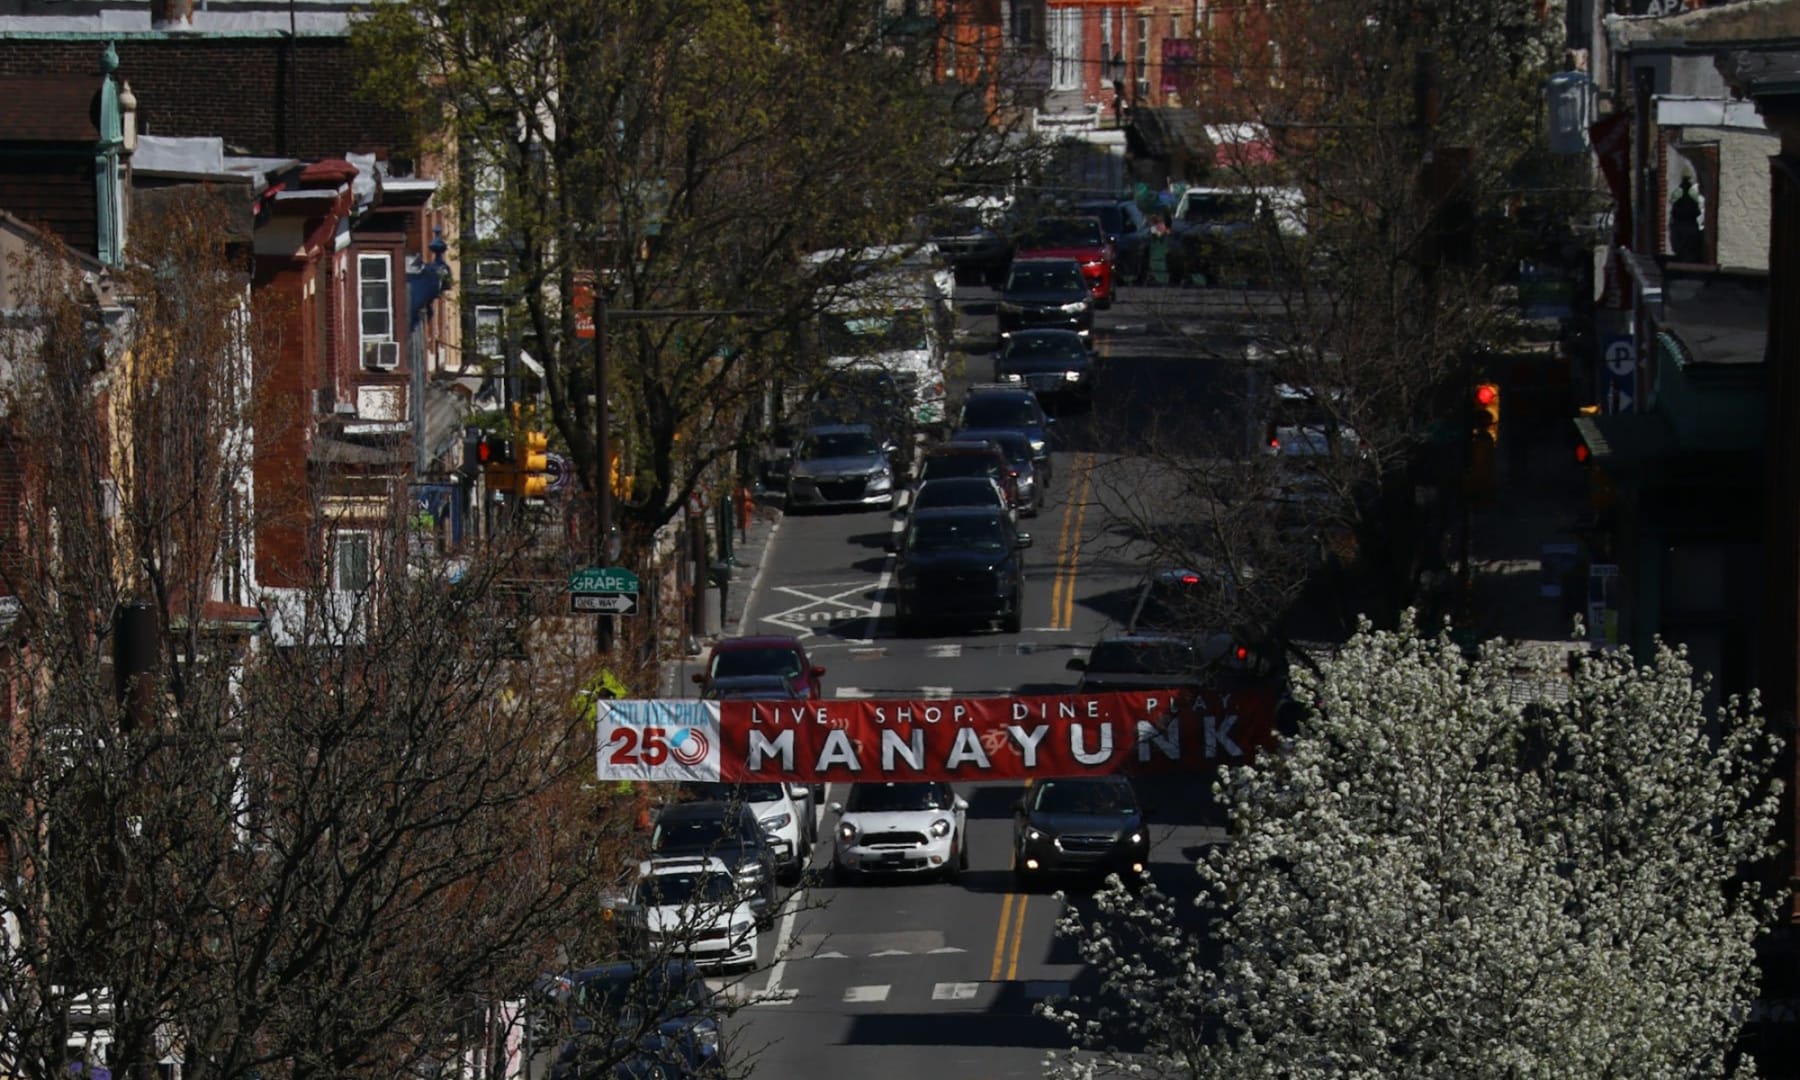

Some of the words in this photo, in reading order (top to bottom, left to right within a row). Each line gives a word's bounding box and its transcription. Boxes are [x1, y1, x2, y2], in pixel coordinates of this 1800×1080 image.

[1615, 347, 1629, 369] P
[572, 576, 624, 590] GRAPE
[598, 599, 617, 608] WAY
[609, 702, 709, 725] PHILADELPHIA
[875, 704, 974, 724] SHOP.
[1012, 700, 1109, 720] DINE.
[610, 727, 709, 766] 250
[749, 714, 1244, 771] MANAYUNK
